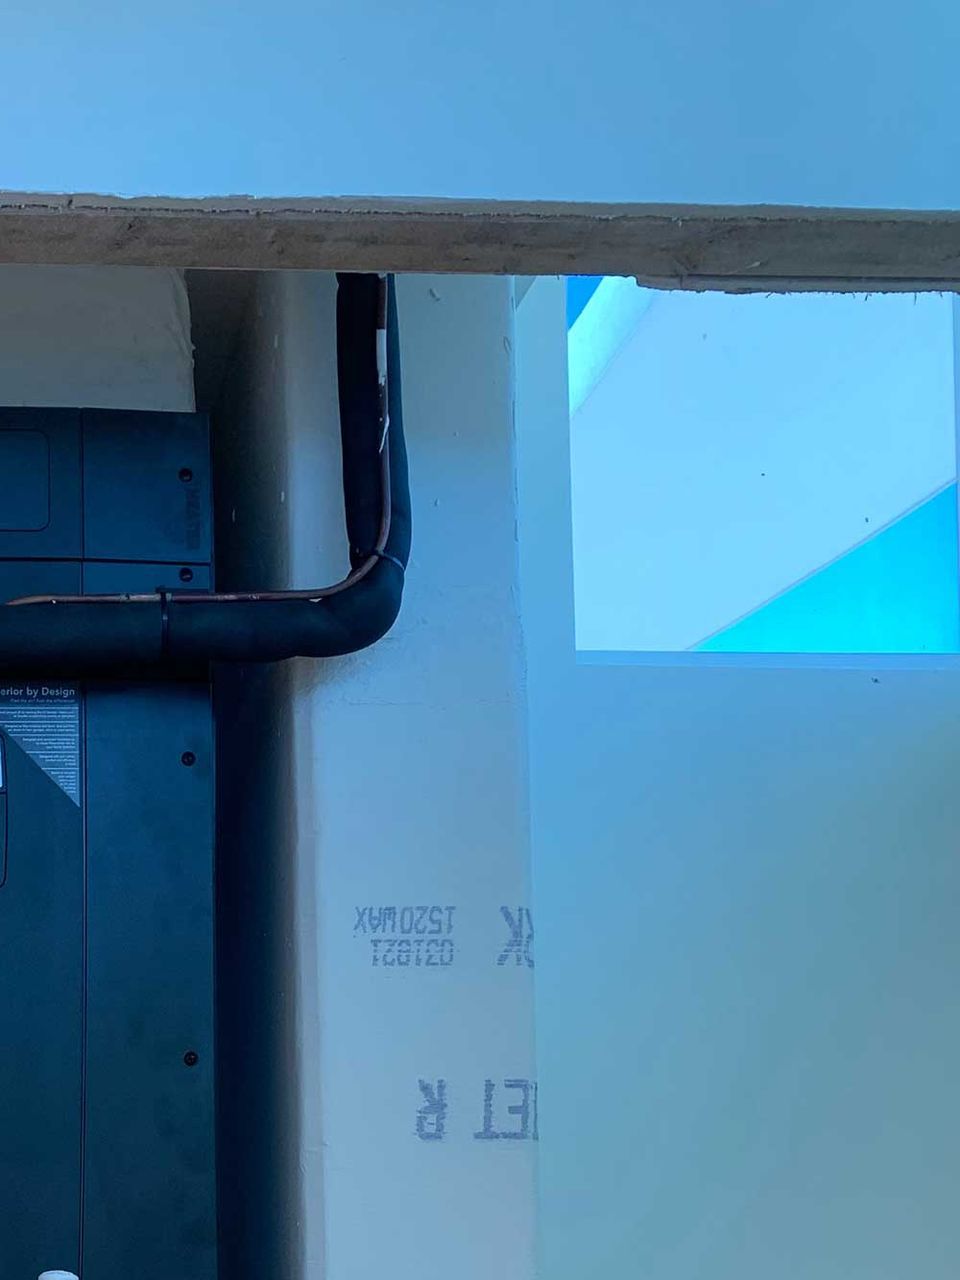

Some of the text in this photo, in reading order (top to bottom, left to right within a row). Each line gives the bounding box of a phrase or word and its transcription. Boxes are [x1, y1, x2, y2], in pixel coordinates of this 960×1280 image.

[26, 687, 39, 698] by
[41, 687, 75, 697] Design
[473, 1079, 538, 1140] ET
